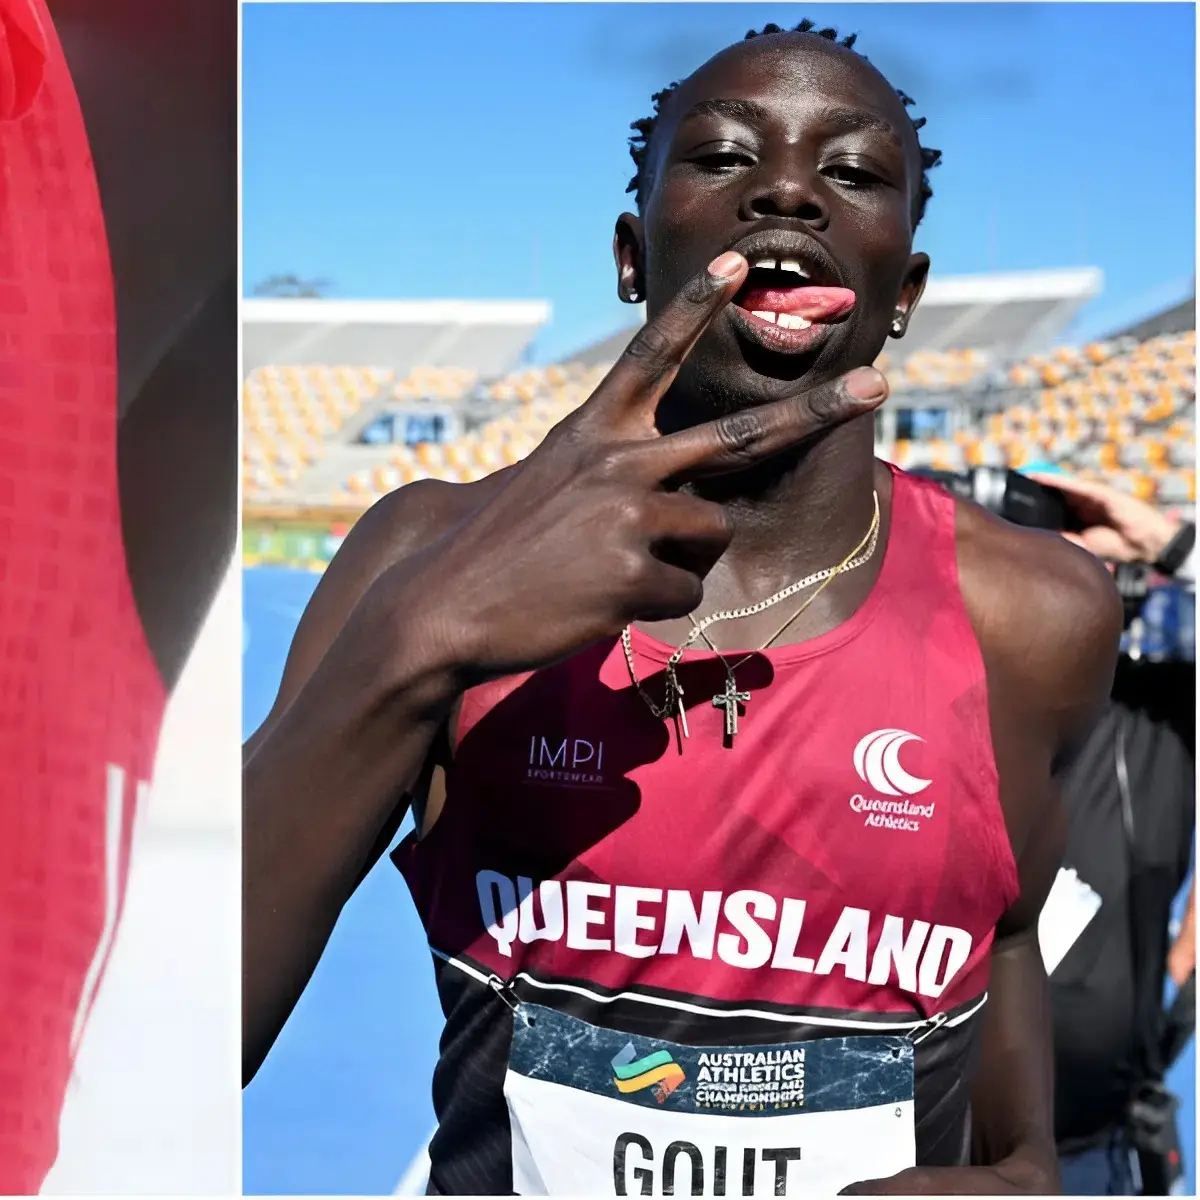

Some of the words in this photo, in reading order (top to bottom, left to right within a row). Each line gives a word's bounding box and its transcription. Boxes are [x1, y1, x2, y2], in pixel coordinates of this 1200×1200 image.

[529, 735, 603, 770] IMPI
[476, 869, 973, 998] QUEENSLAND
[697, 1063, 805, 1083] ATHLETICS
[698, 1049, 805, 1067] AUSTRALIAN
[613, 1132, 801, 1197] GOUT
